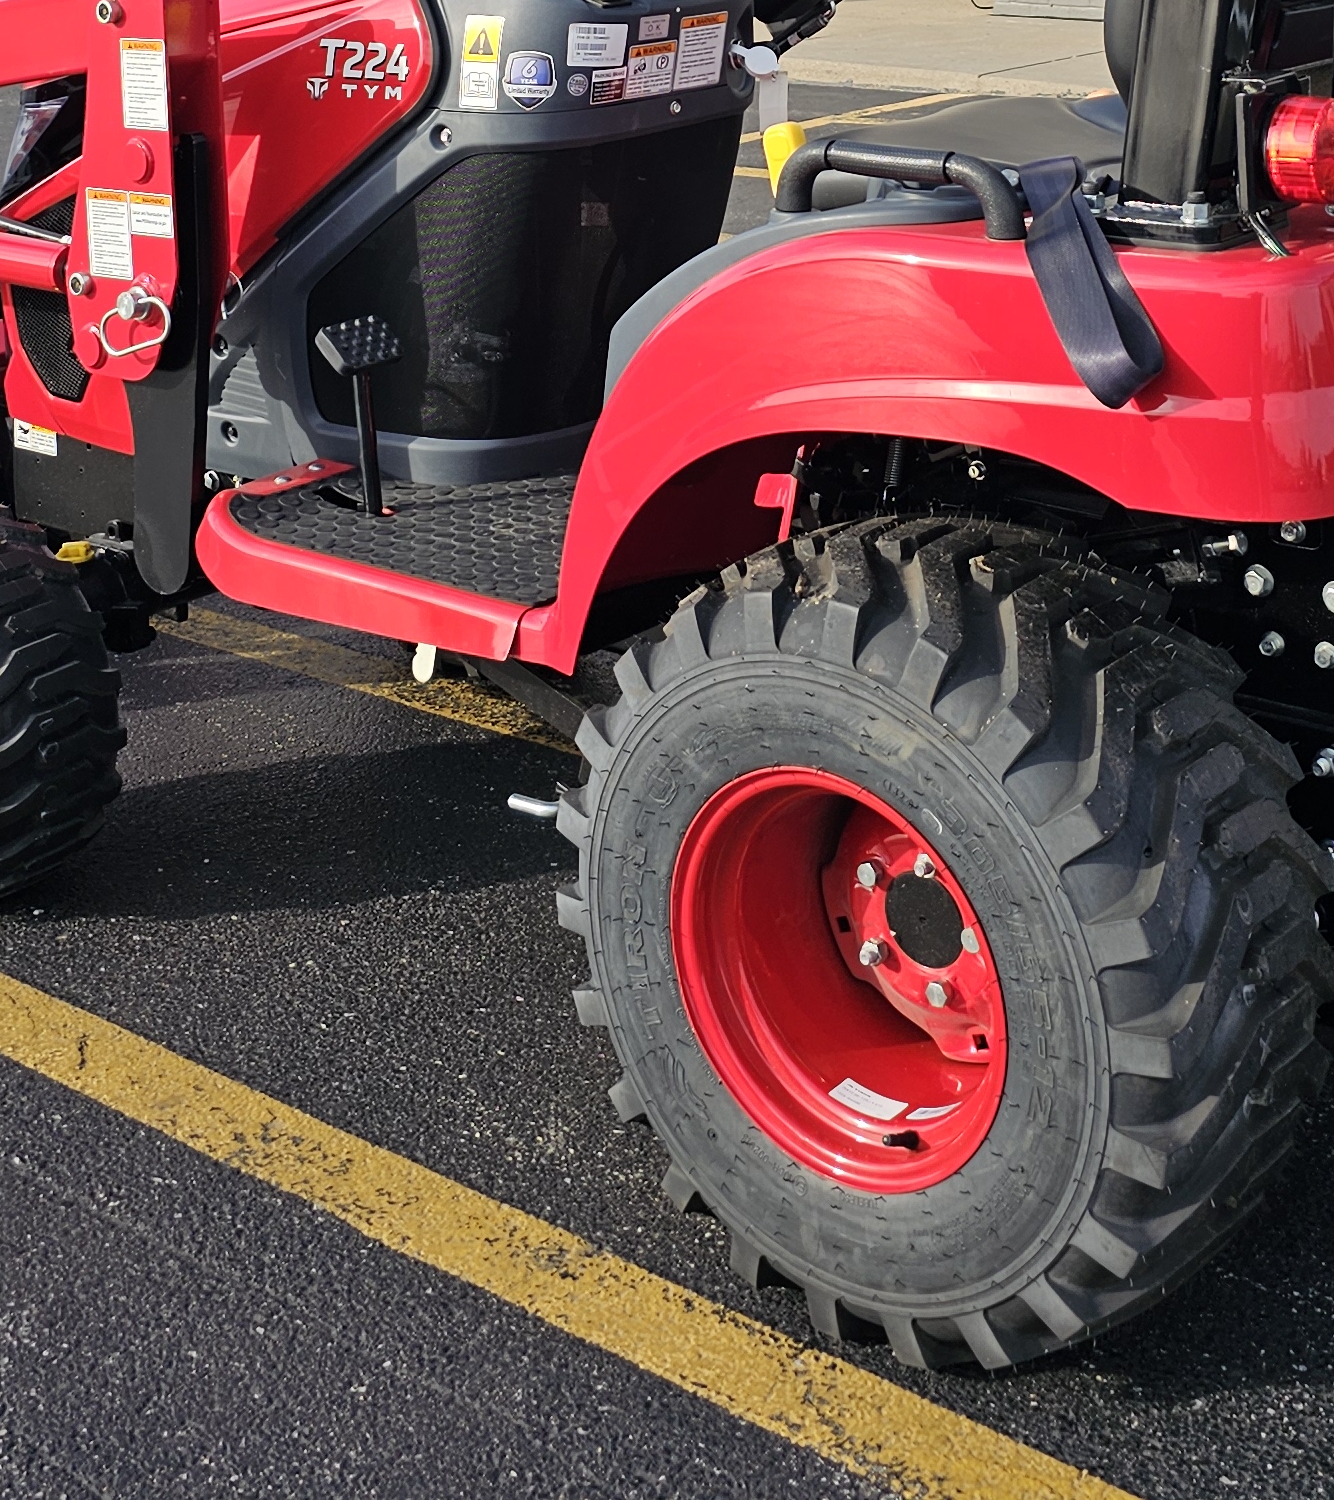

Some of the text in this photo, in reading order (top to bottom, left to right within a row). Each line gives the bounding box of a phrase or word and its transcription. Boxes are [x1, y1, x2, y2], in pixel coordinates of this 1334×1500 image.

[642, 44, 672, 55] WARNING
[320, 37, 409, 82] T224
[522, 60, 538, 79] 6
[341, 83, 403, 100] TYM
[618, 834, 669, 1041] TIRON
